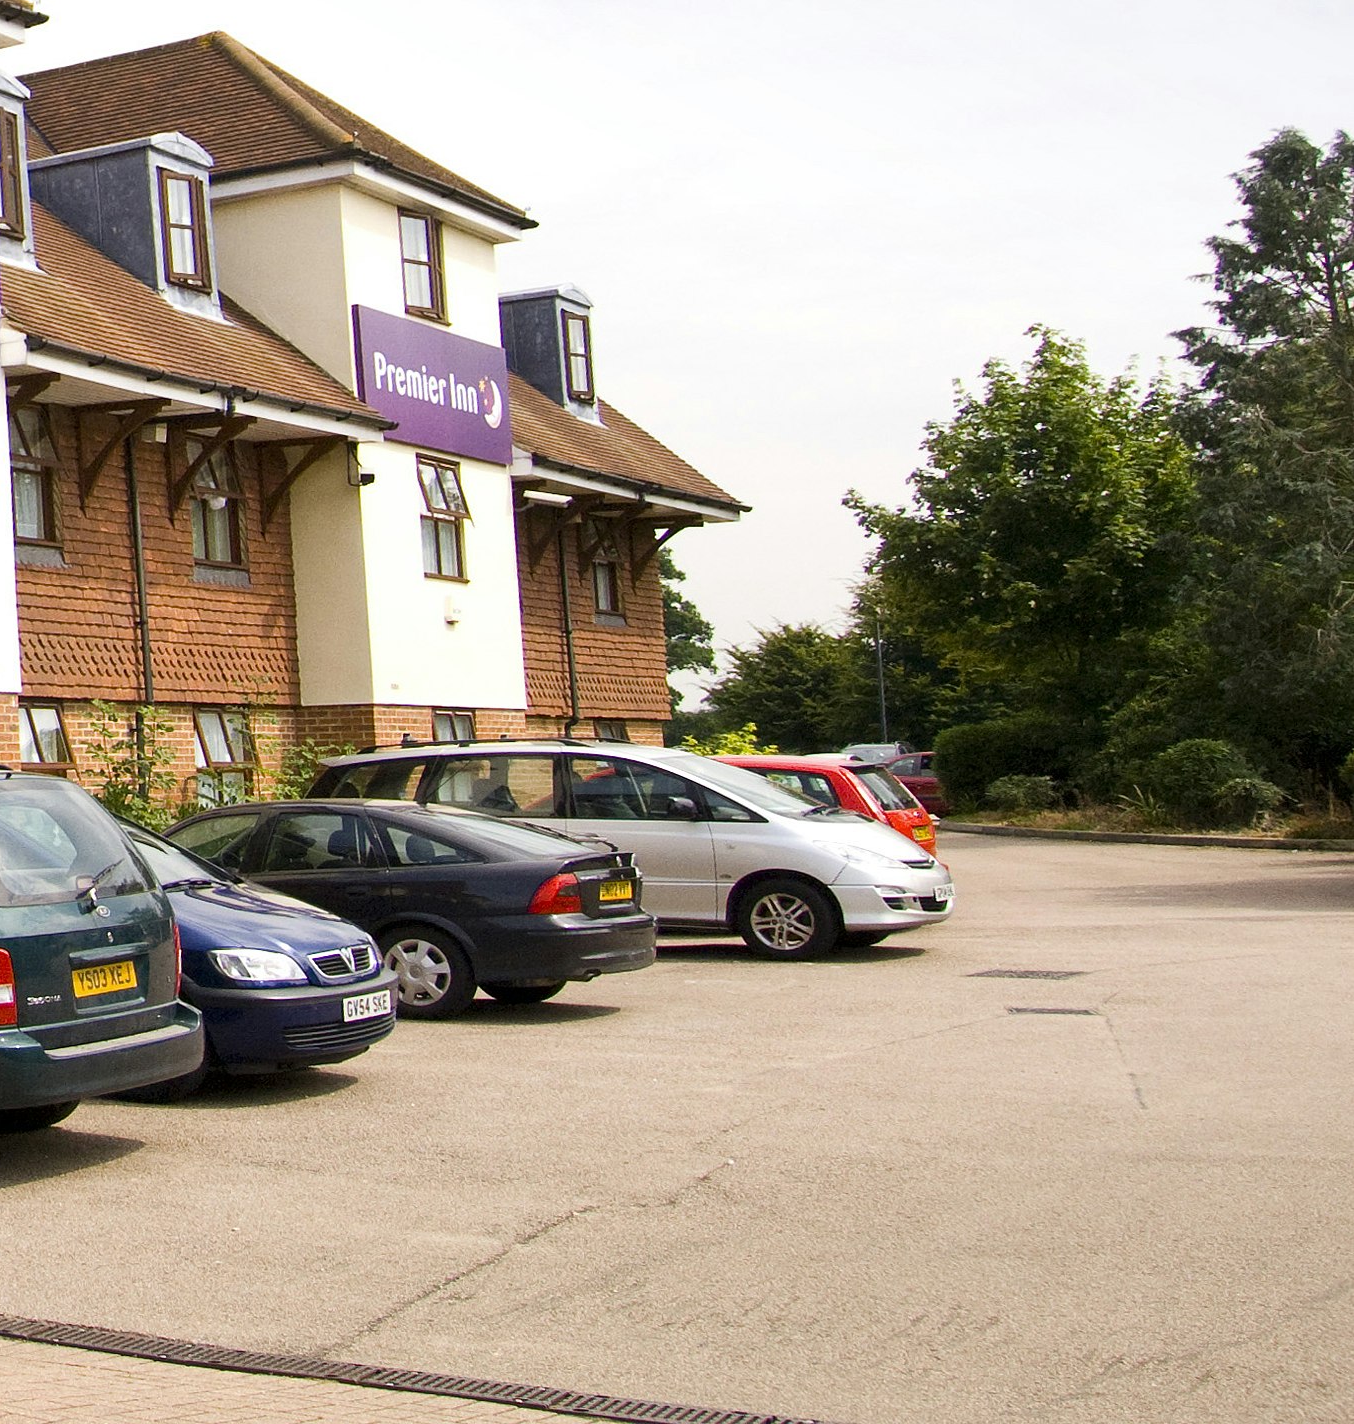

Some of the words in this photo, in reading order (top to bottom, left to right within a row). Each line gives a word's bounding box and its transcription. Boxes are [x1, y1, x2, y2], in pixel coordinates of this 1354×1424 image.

[373, 351, 446, 406] Premier
[450, 373, 479, 415] Inn
[77, 967, 108, 991] YS03
